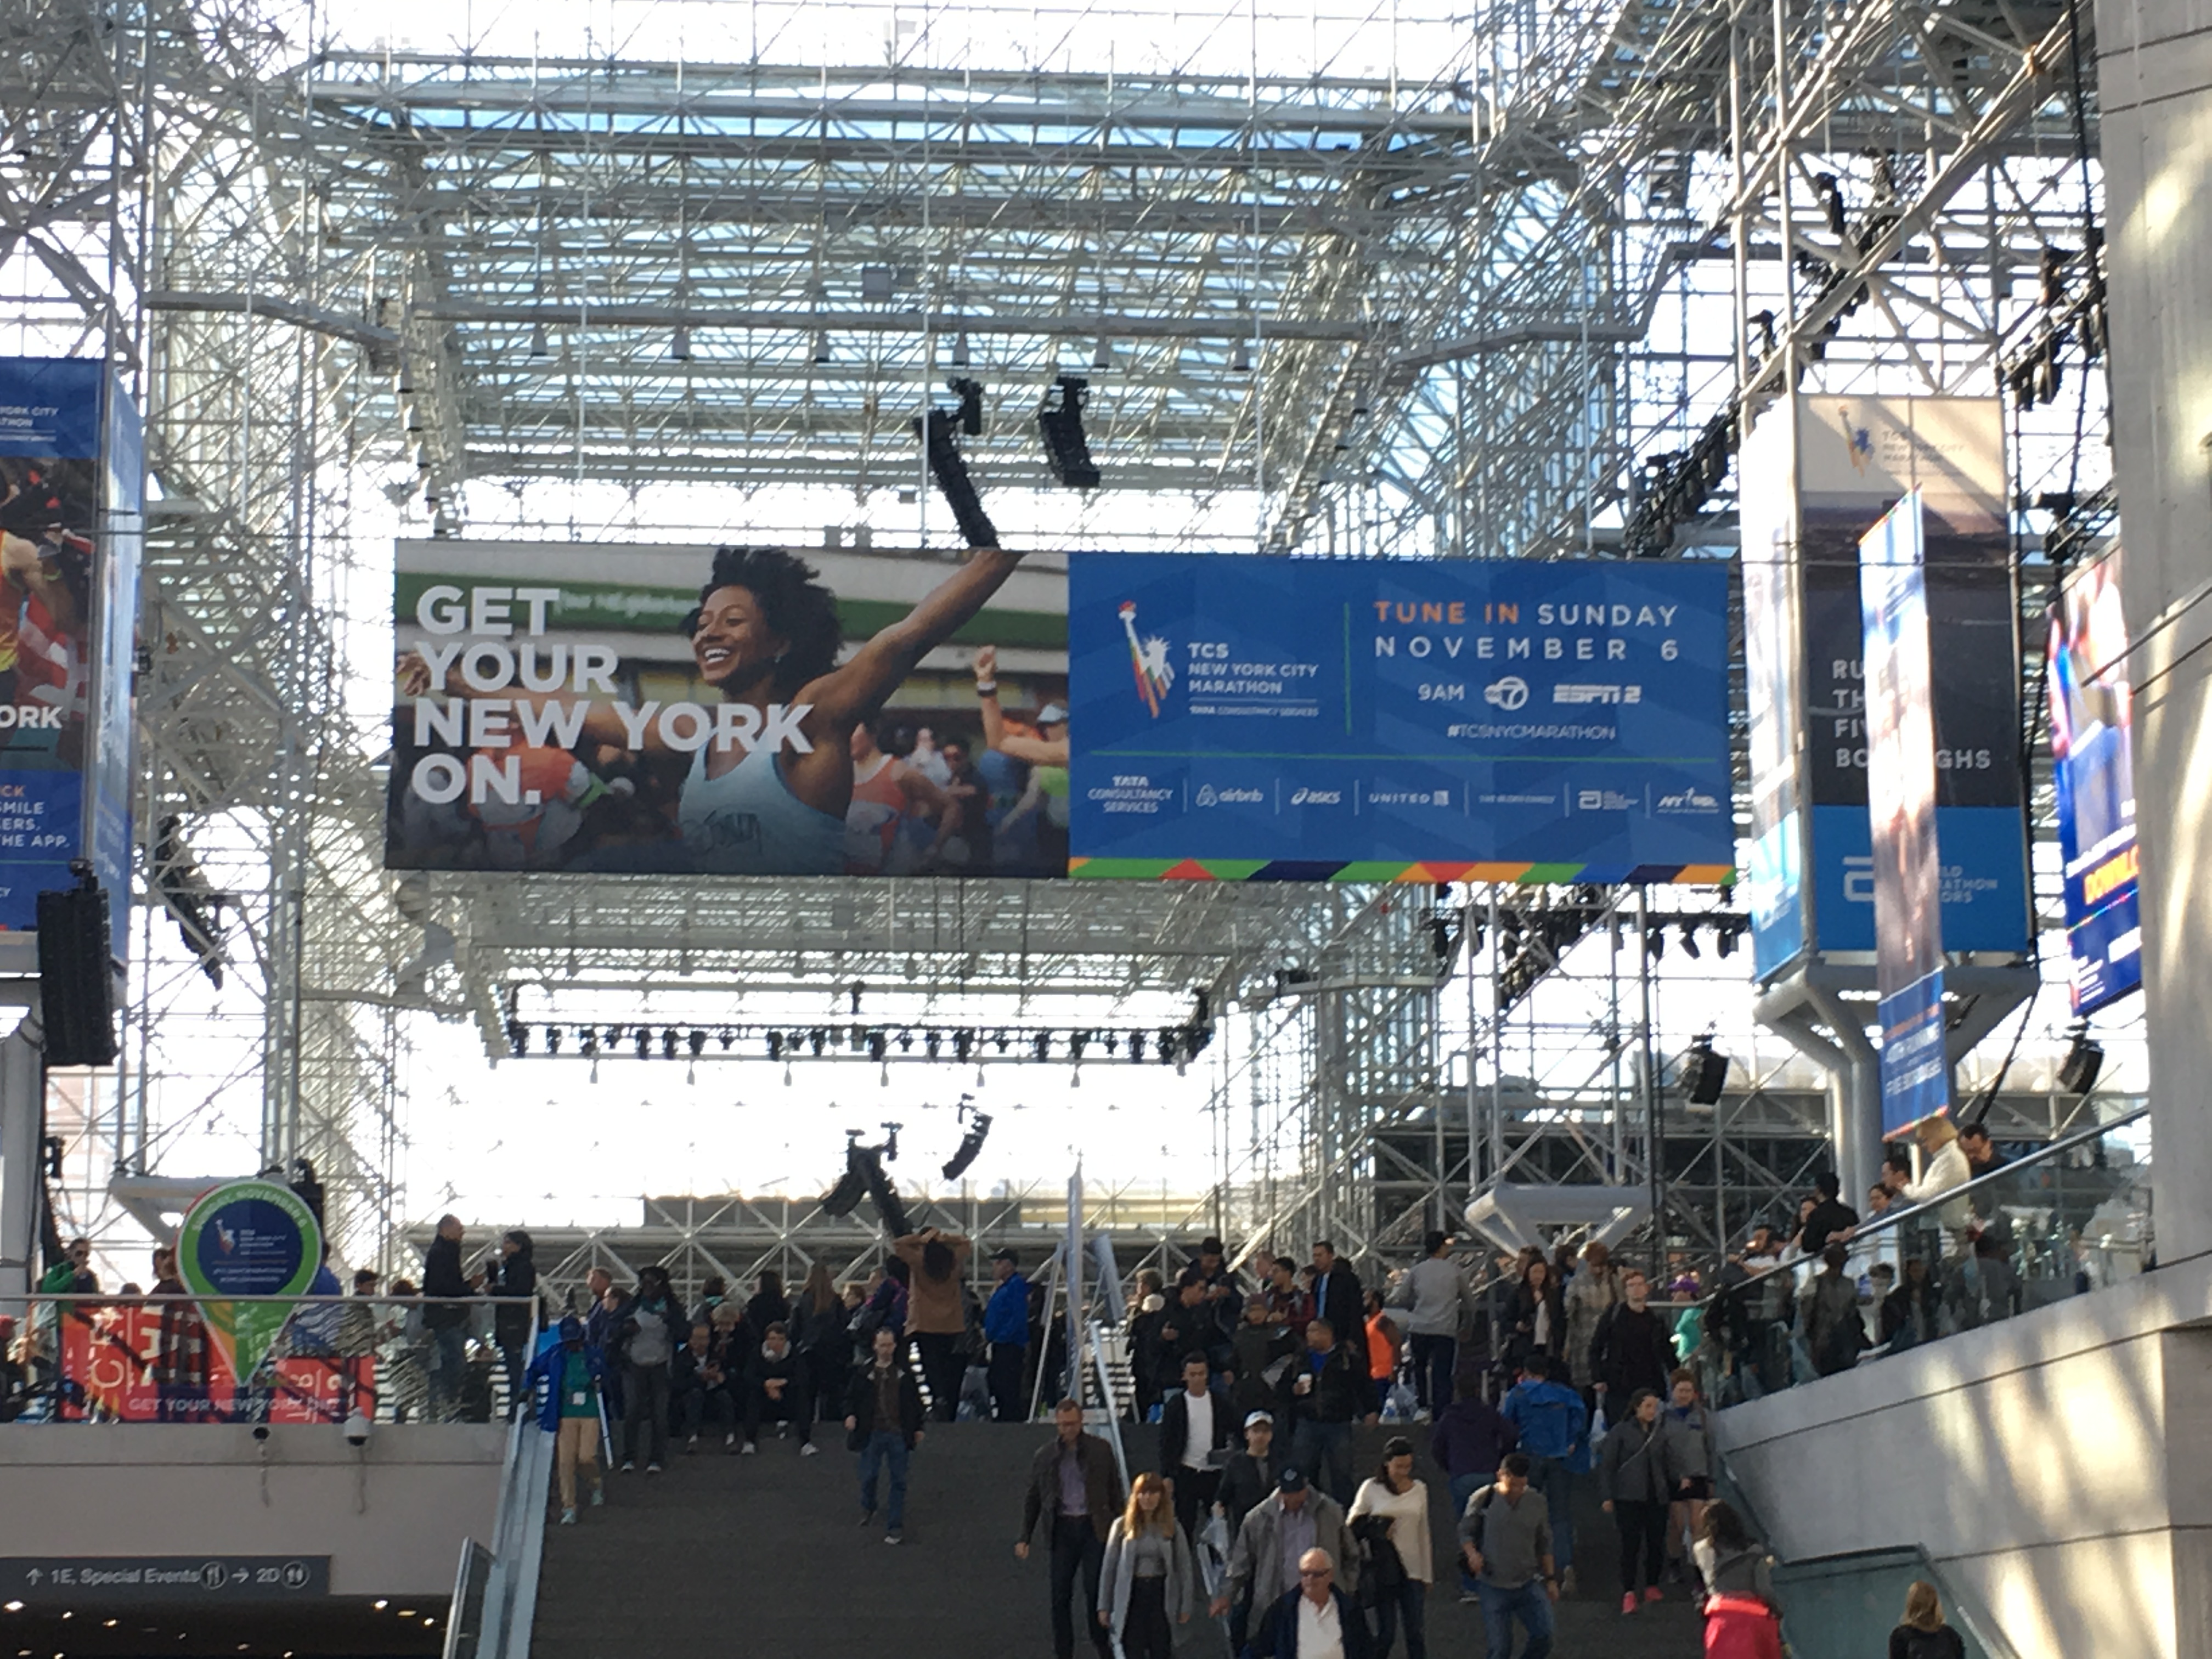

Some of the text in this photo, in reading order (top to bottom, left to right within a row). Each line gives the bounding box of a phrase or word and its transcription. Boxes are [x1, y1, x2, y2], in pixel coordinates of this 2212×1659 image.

[416, 585, 560, 636] GET
[1373, 601, 1678, 627] TUNE IN SUNDAY
[1187, 642, 1229, 659] TCS
[1375, 637, 1679, 661] NOVEMBER 6
[415, 641, 618, 693] YOUR
[1188, 663, 1319, 678] NEW YORK CITY
[1832, 659, 1865, 680] RU
[1188, 680, 1283, 694] MARATHON
[1418, 683, 1464, 702] 9AM
[1832, 689, 1865, 709] TH
[414, 698, 815, 753] NEW YORK
[1447, 724, 1616, 741] #TCSNYCMARATHON
[1835, 719, 1867, 739] FI
[1836, 748, 1991, 769] BOGHS
[411, 753, 541, 805] ON.
[1112, 776, 1149, 787] TATA
[0, 785, 26, 797] CK
[1087, 788, 1173, 801] CONSULTANCY
[1368, 792, 1431, 804] UNITED
[0, 802, 45, 815] MILE
[1103, 802, 1159, 814] SERVICES
[0, 817, 41, 831] ERS,
[129, 1397, 161, 1410] GET
[166, 1398, 210, 1412] YOUR
[51, 1567, 280, 1587] 1E, Special Events 2D
